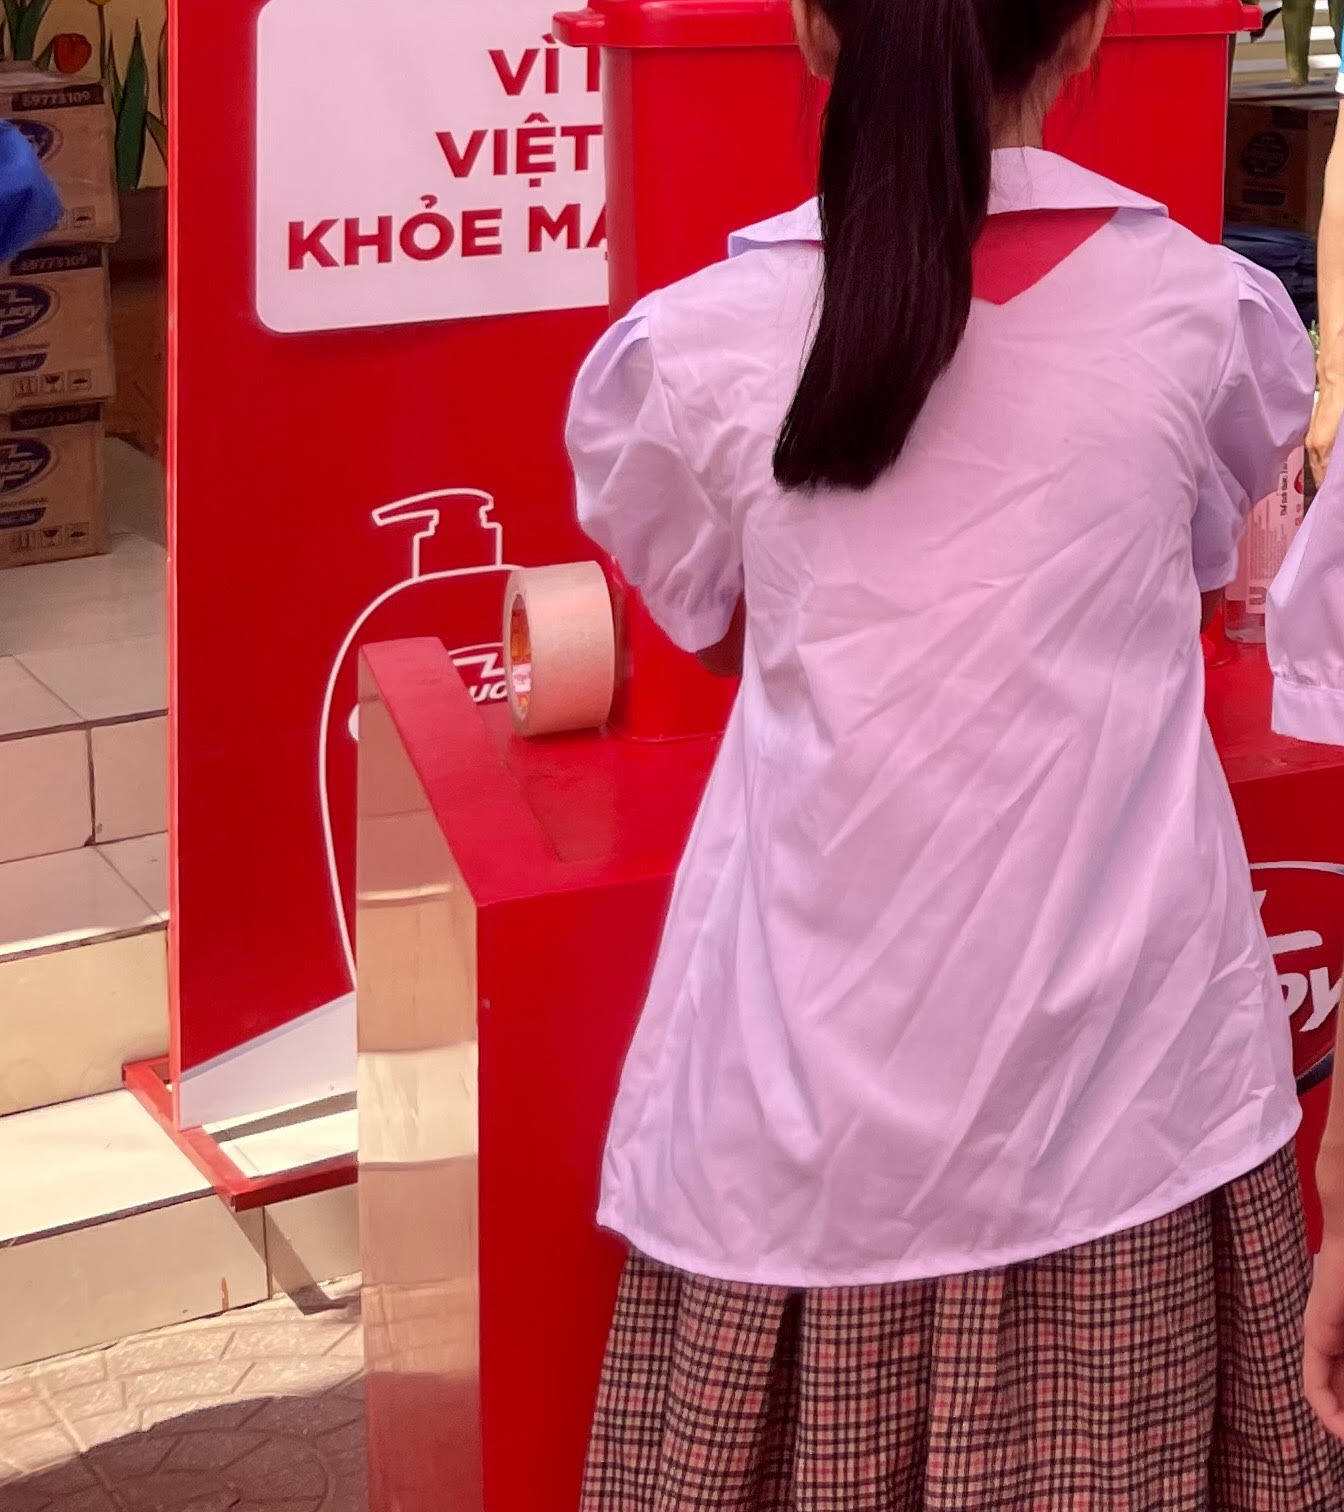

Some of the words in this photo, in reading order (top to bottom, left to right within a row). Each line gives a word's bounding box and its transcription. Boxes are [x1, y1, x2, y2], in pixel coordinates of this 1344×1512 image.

[487, 33, 562, 97] VÌ
[434, 111, 603, 188] VIỆT
[286, 194, 504, 270] KHỎE
